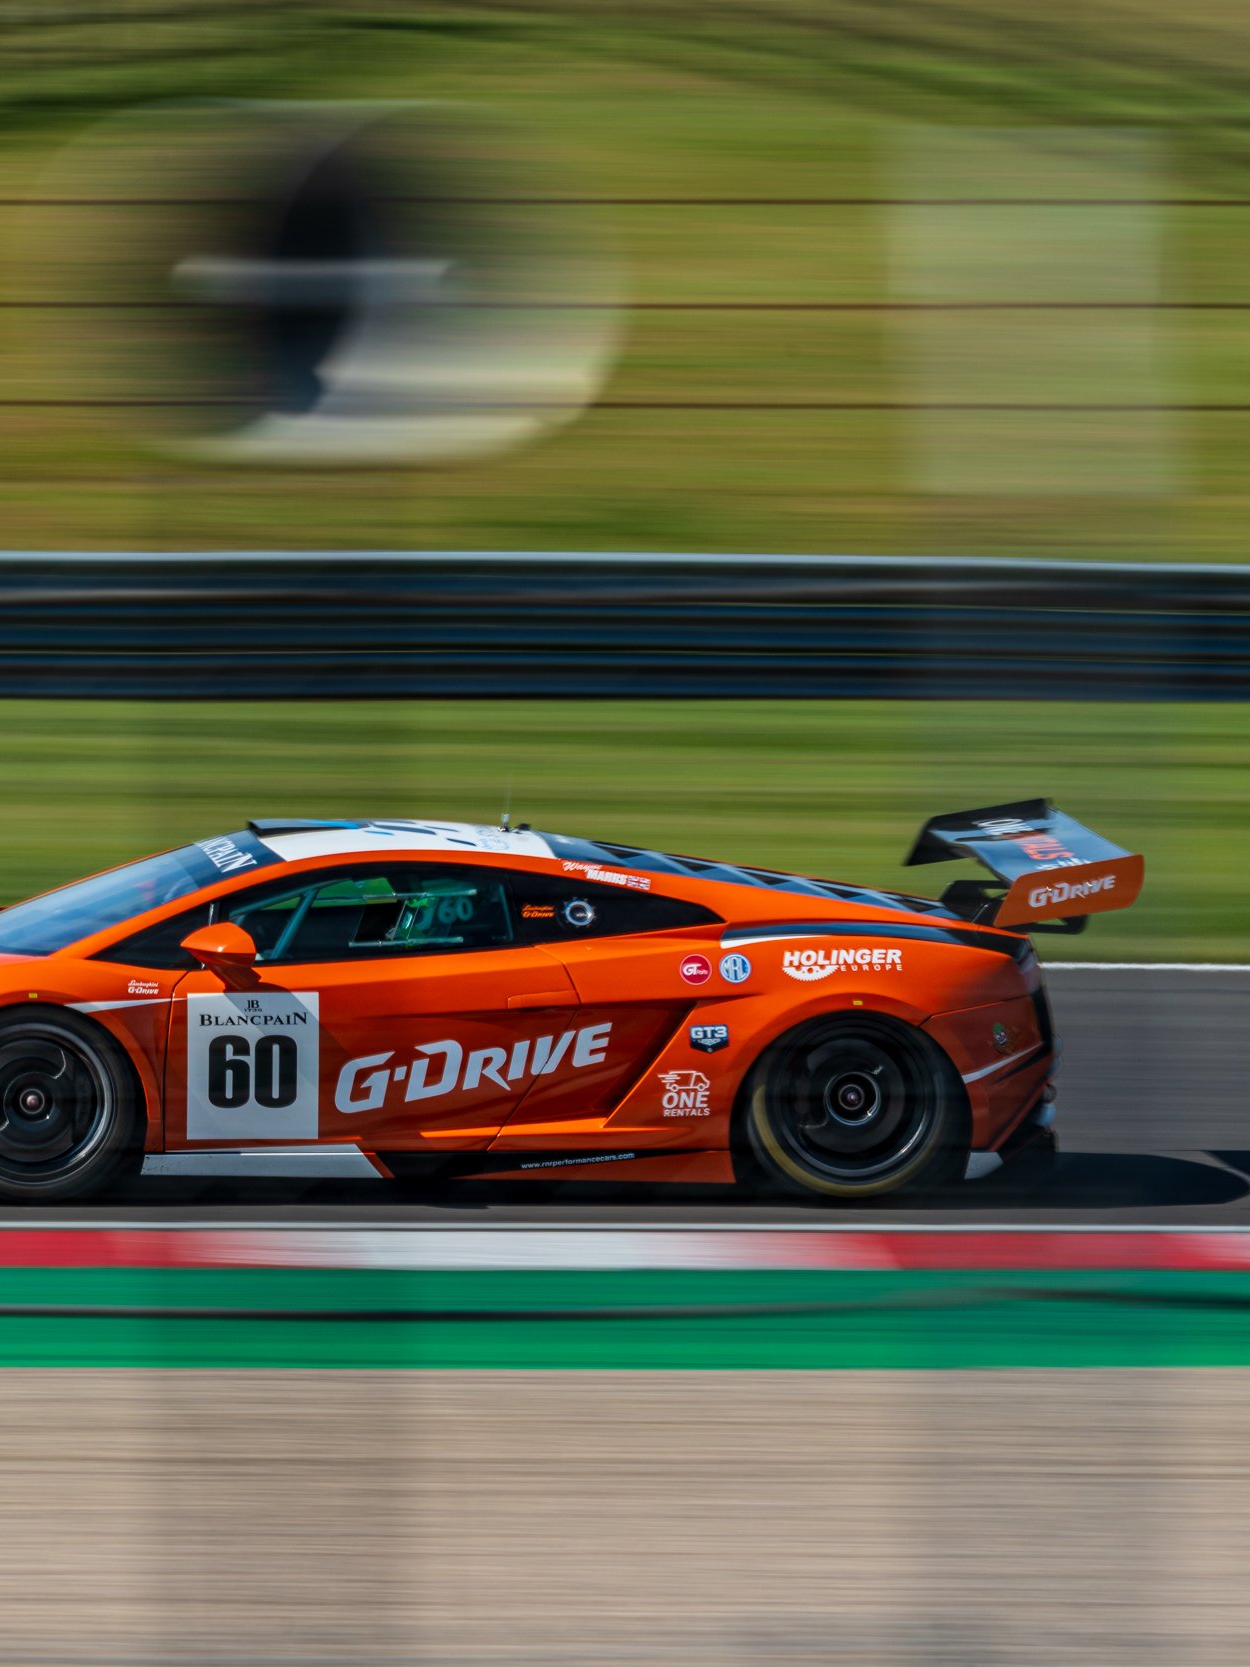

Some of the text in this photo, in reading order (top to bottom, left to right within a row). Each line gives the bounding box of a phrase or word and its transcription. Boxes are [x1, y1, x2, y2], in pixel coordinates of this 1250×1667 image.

[562, 860, 603, 872] Wayne
[783, 949, 902, 966] HOLINGER
[839, 964, 903, 972] EUROPE
[199, 1011, 308, 1027] BLANCPAIN
[690, 1026, 727, 1039] GT3
[207, 1034, 298, 1109] 60
[662, 1091, 710, 1108] ONE
[663, 1108, 711, 1117] RENTALS
